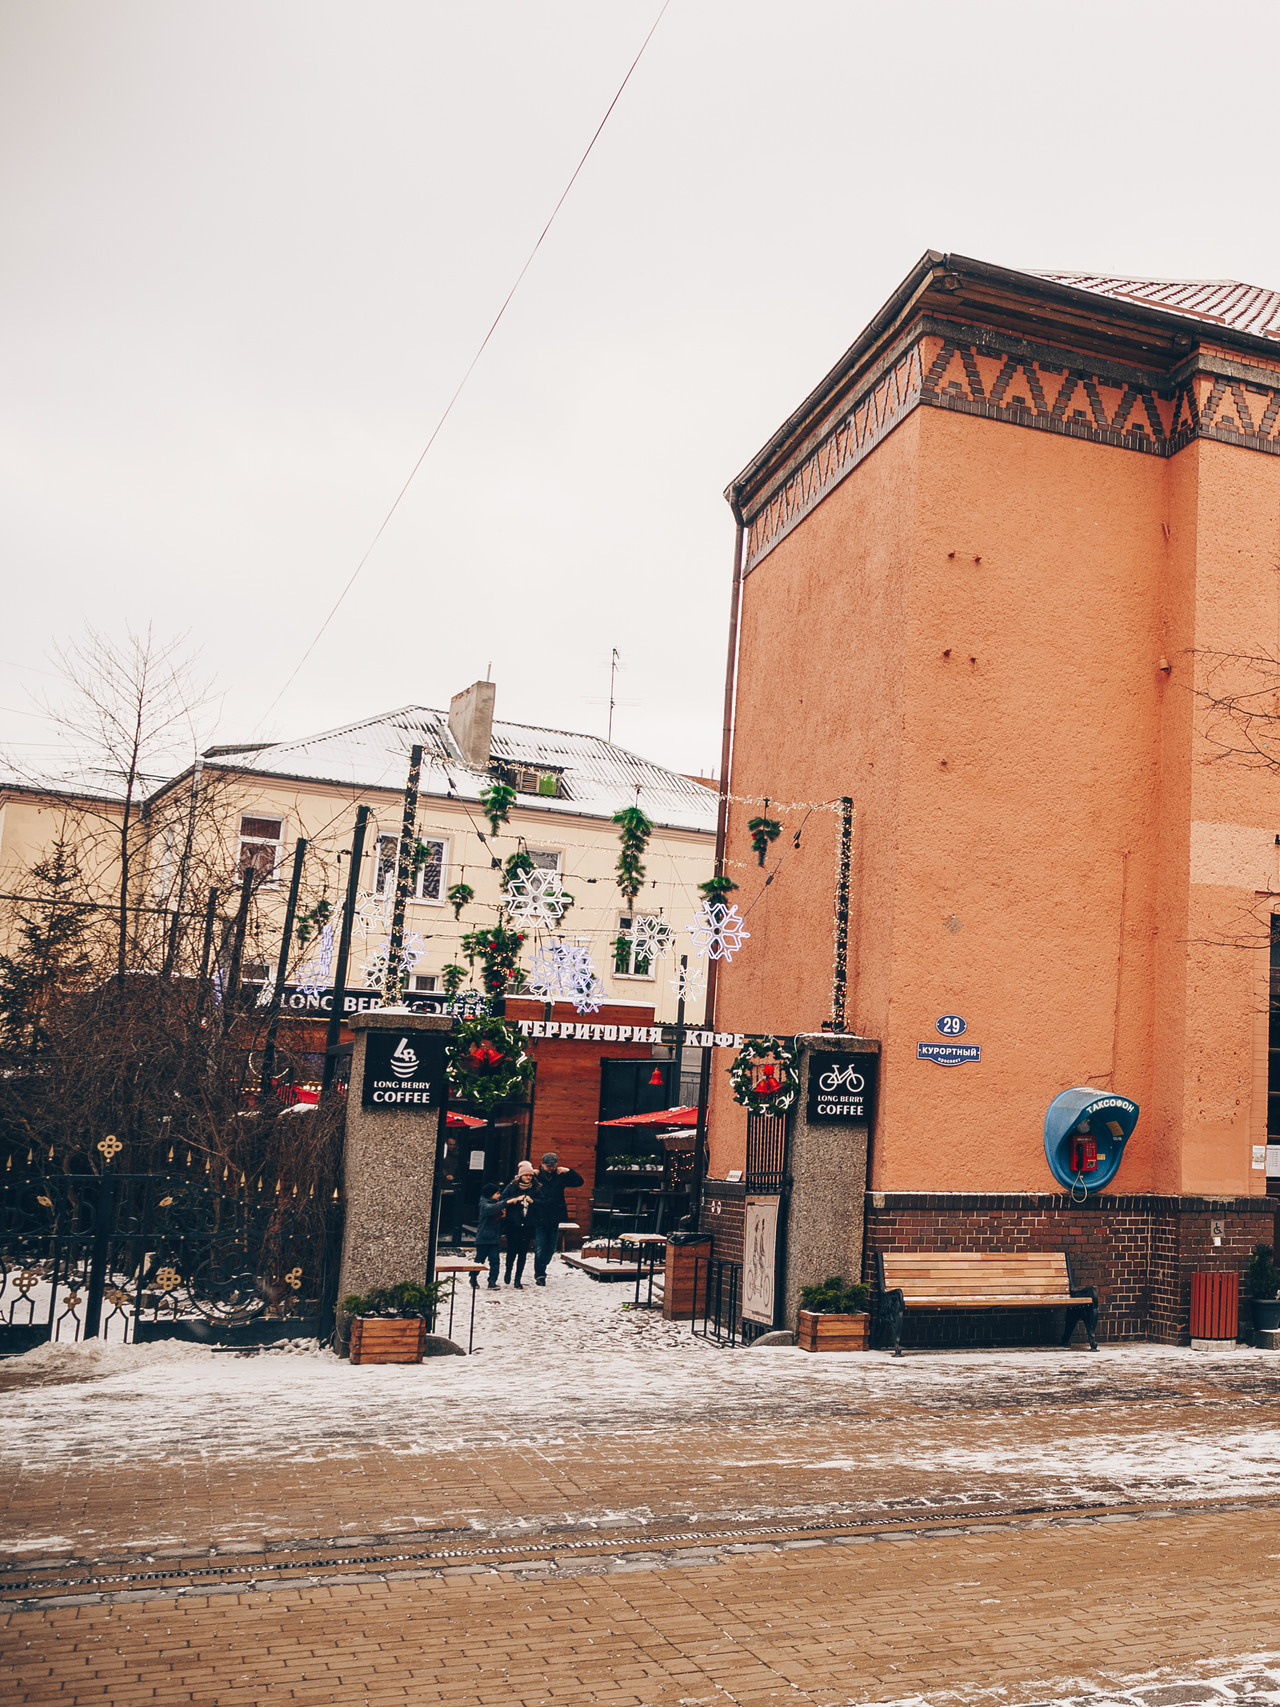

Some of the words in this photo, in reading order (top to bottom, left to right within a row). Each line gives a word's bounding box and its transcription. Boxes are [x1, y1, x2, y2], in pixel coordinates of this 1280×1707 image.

[280, 993, 334, 1010] LONG
[343, 997, 409, 1012] BERY
[943, 1018, 960, 1033] 29
[518, 1020, 663, 1043] ТЕРРИТОРИЯ
[685, 1030, 745, 1048] КОФЕ
[922, 1047, 977, 1056] КУРОРТНЫЙ
[373, 1080, 400, 1089] LONG
[401, 1081, 431, 1089] BERRY
[373, 1091, 430, 1103] COFFEE
[817, 1104, 864, 1115] COFFEE
[1086, 1099, 1135, 1114] ТАКСОФОН
